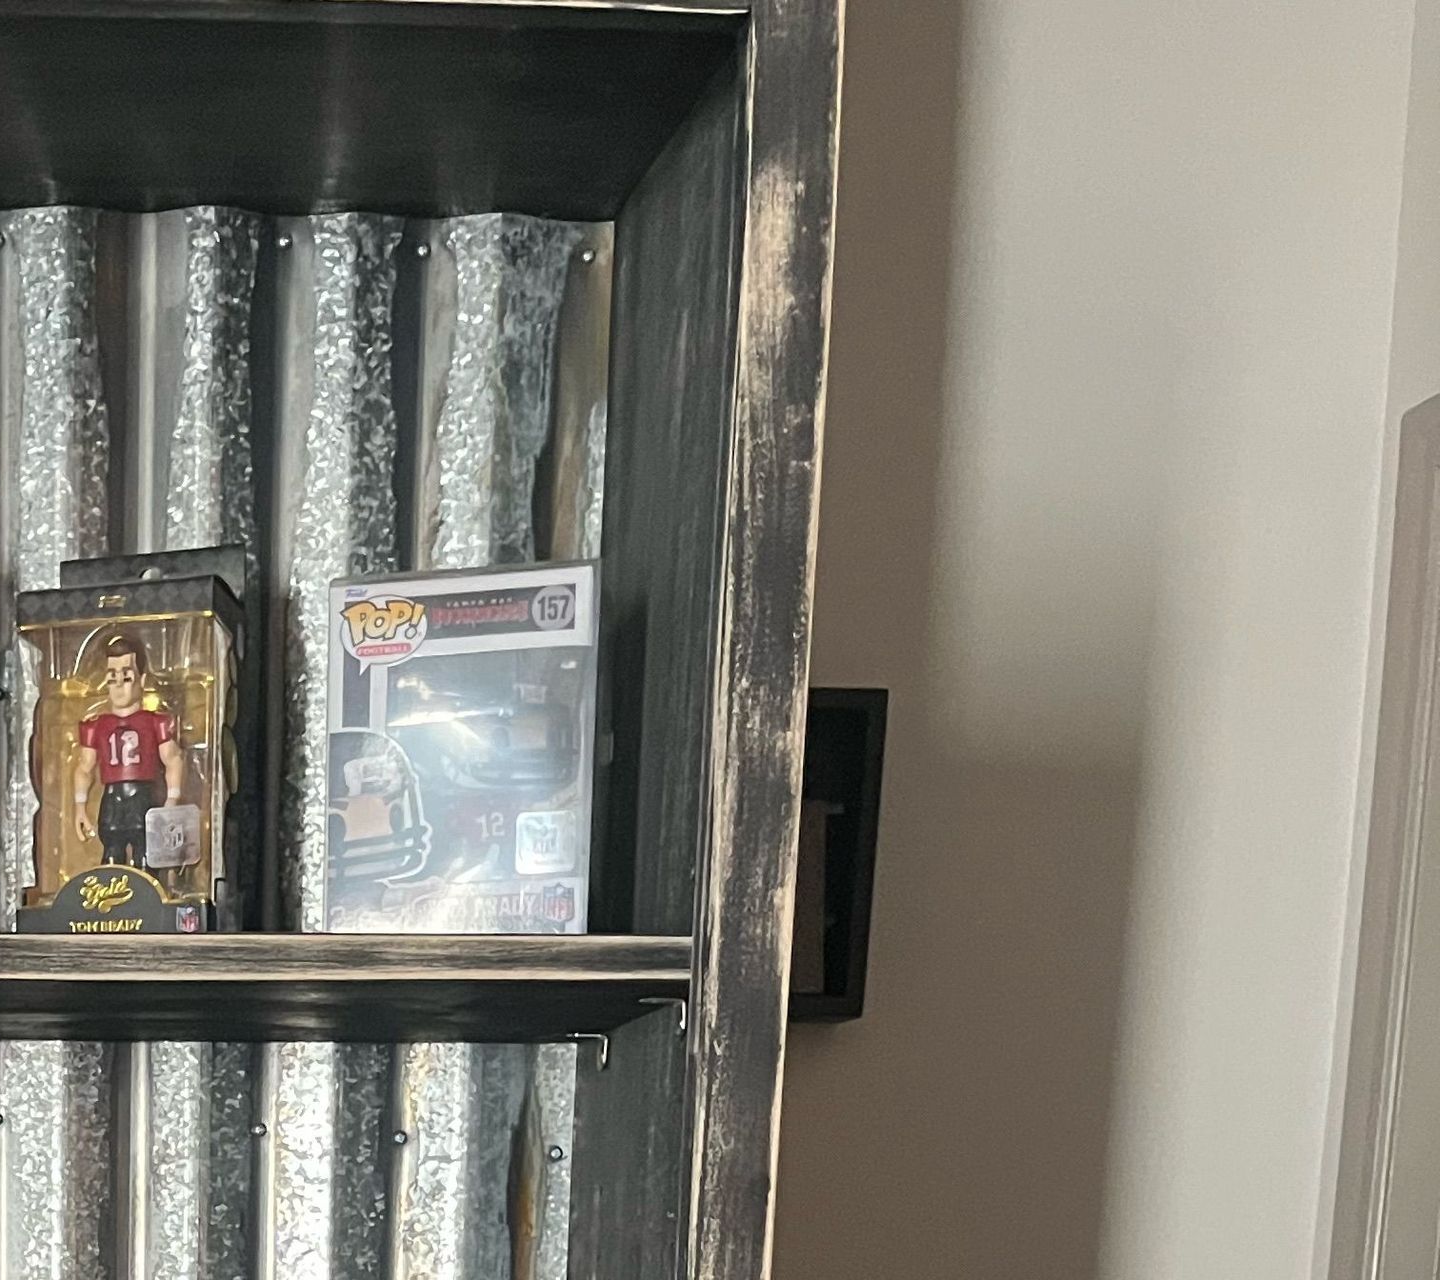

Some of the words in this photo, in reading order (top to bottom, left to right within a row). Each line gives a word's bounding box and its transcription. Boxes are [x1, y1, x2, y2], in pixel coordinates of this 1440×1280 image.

[340, 600, 426, 647] POP!
[537, 595, 569, 621] 157
[108, 730, 140, 766] 12
[475, 812, 505, 838] 12
